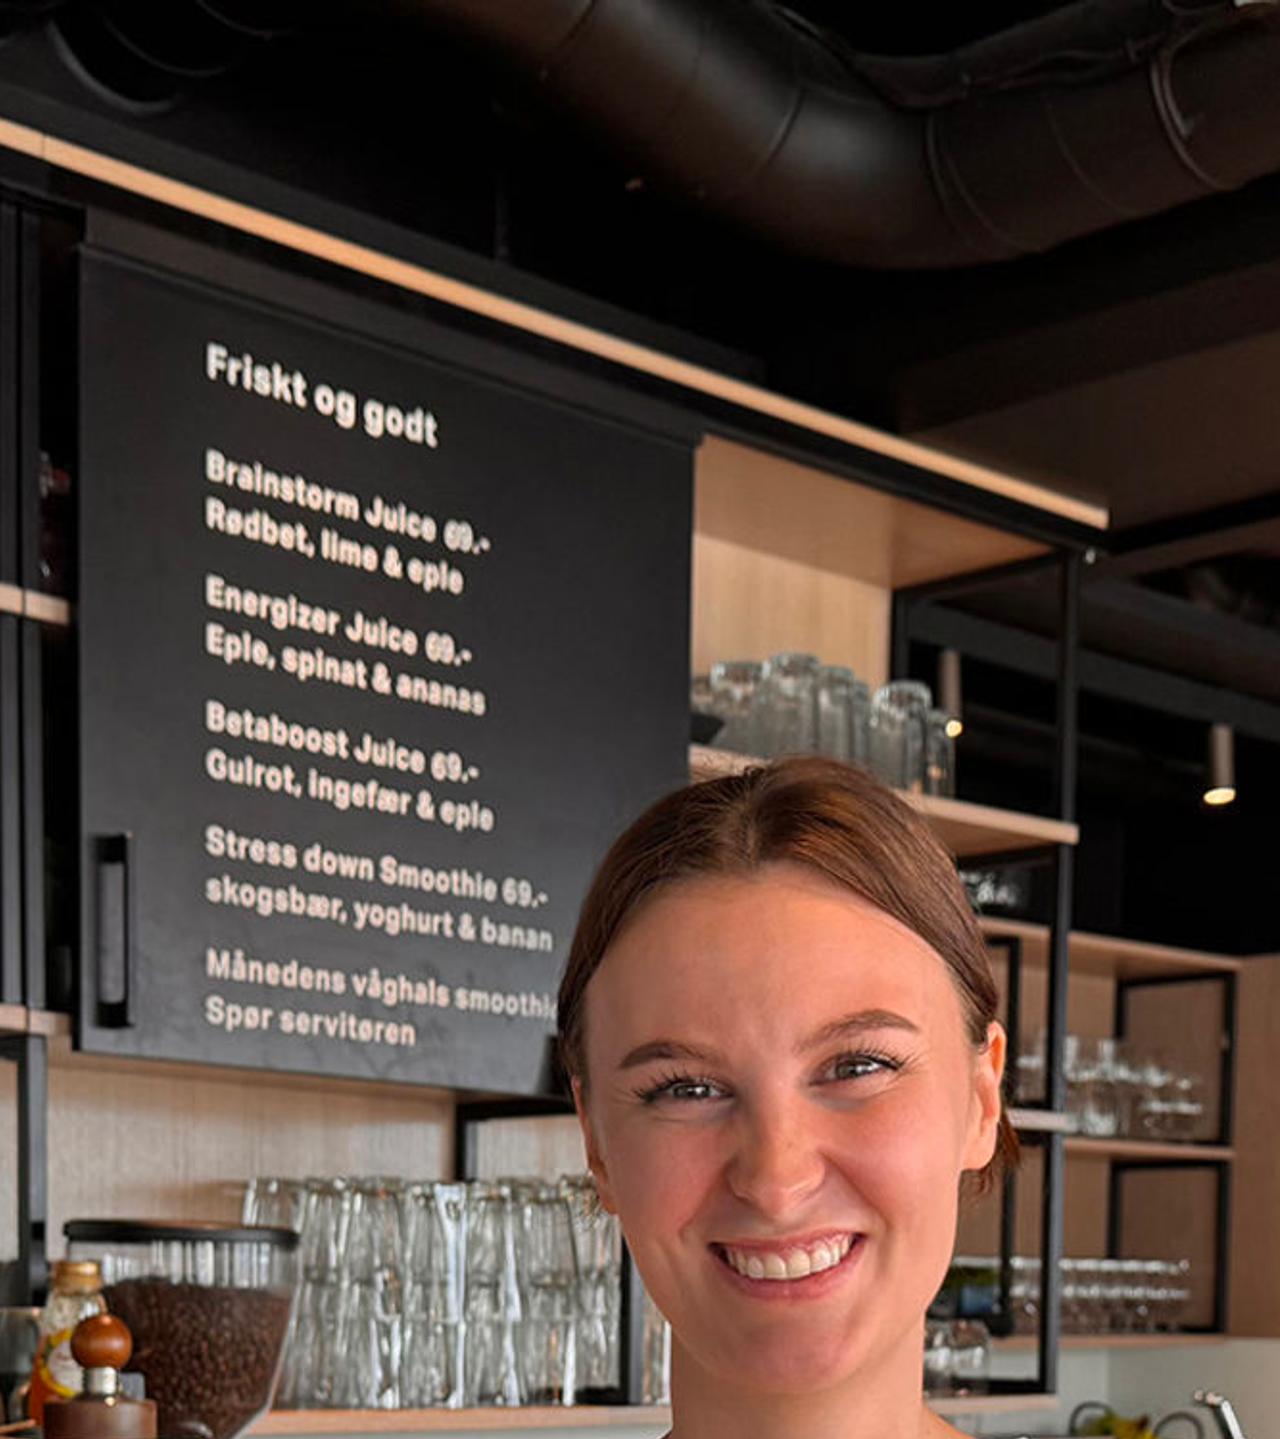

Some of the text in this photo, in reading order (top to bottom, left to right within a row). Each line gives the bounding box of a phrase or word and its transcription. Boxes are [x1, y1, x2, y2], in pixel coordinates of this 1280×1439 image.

[207, 342, 437, 448] Friskt og godt
[206, 449, 359, 521] Brainstorm
[364, 496, 437, 543] Juice
[206, 497, 464, 595] Rødbet, lime & eple
[206, 574, 340, 636] Energizer
[345, 611, 418, 656] Juice
[206, 623, 485, 716] Eple, spinat & ananas
[206, 700, 349, 759] Betaboost
[353, 734, 425, 774] Juice
[206, 749, 494, 831] Gulrot, ingefær & eple
[206, 825, 297, 869] Stress
[303, 843, 374, 881] down
[379, 855, 497, 902] Smoothie
[206, 875, 553, 951] skogsbær, yoghurt & banan
[207, 948, 346, 994] Månedens
[352, 968, 450, 1007] våghals
[206, 996, 415, 1046] Spør servitøren
